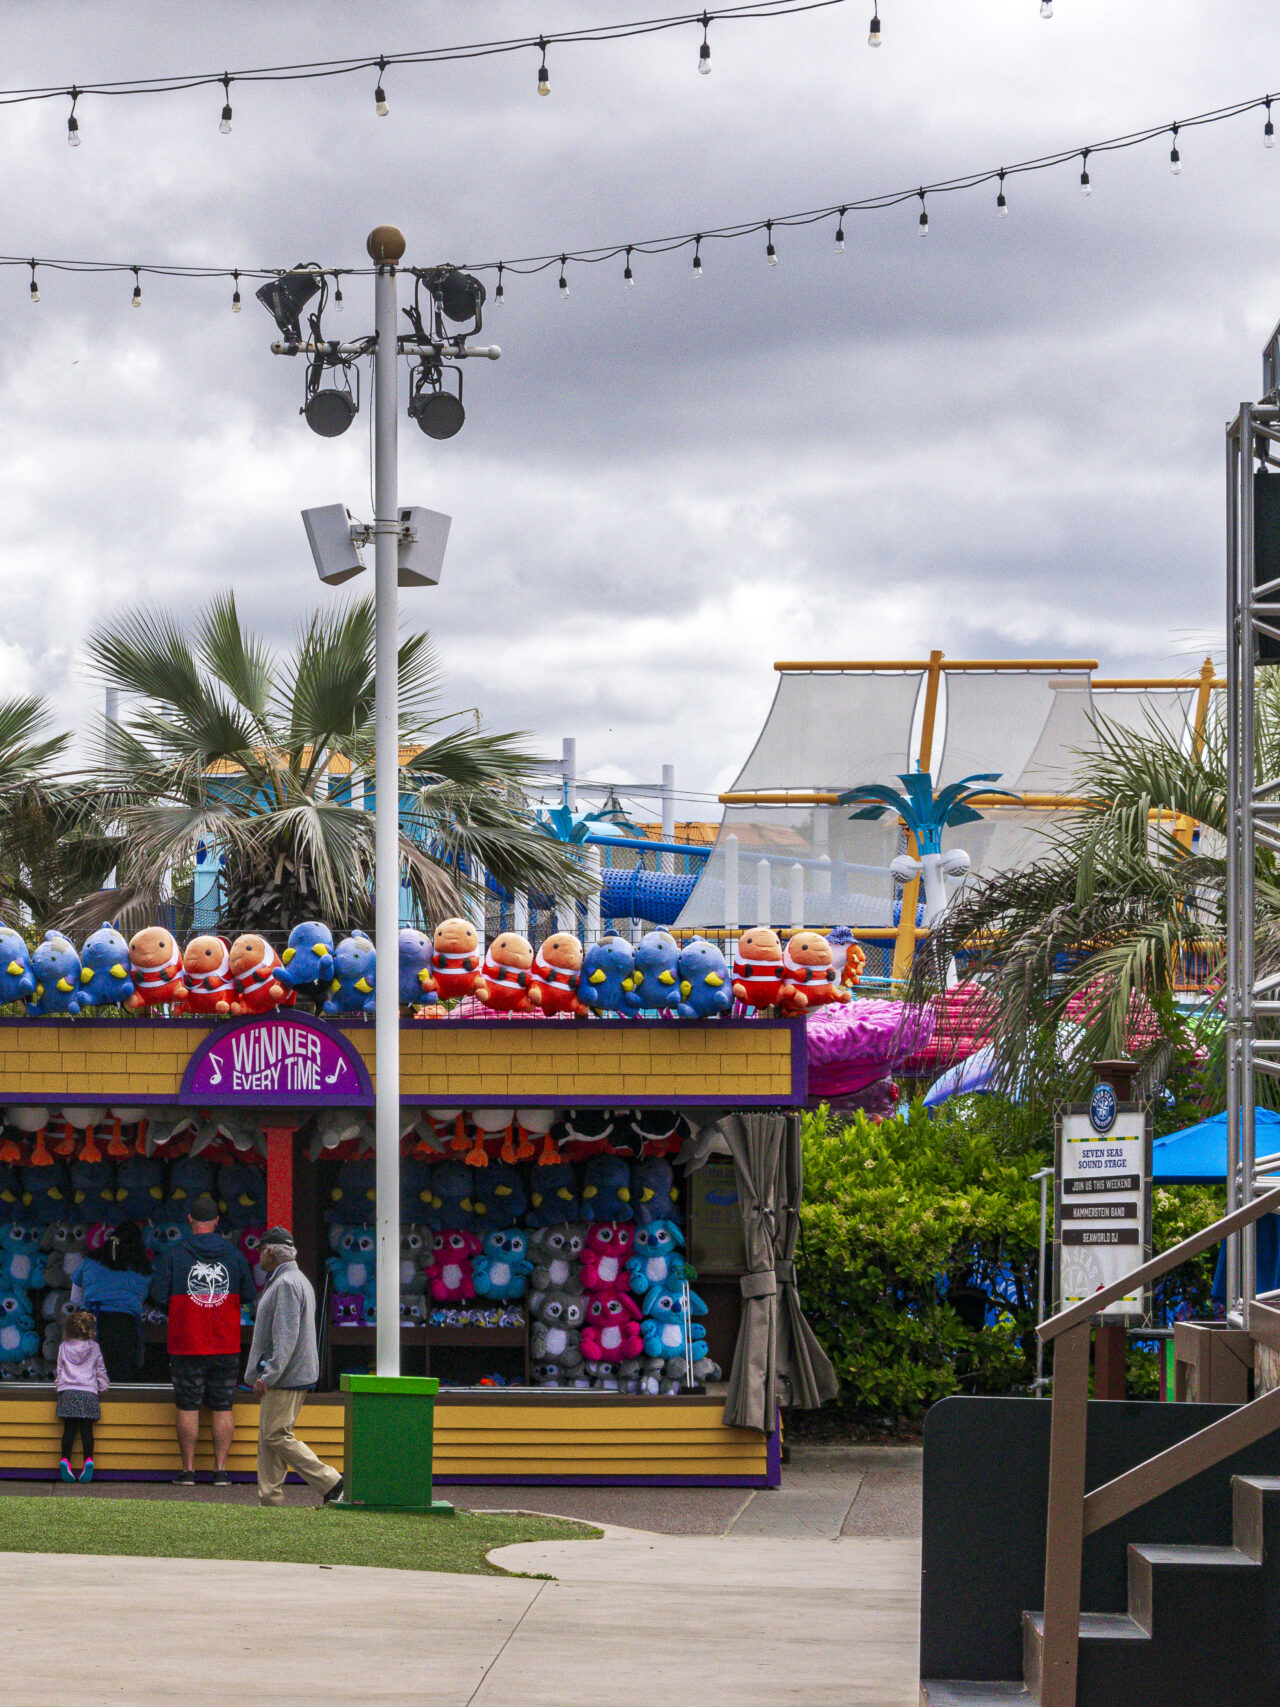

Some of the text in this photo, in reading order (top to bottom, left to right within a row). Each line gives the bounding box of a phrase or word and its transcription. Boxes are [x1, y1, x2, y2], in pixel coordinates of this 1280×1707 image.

[233, 1062, 282, 1090] EVERY
[1082, 1148, 1123, 1158] SEVEN SEAS
[1078, 1160, 1127, 1169] SOUND STAGE
[1072, 1178, 1131, 1191] JOIN US THIS WEEKEND
[1073, 1207, 1125, 1217] HAMMERSTEIN BAND
[1082, 1233, 1119, 1242] SEAWORLD DJ
